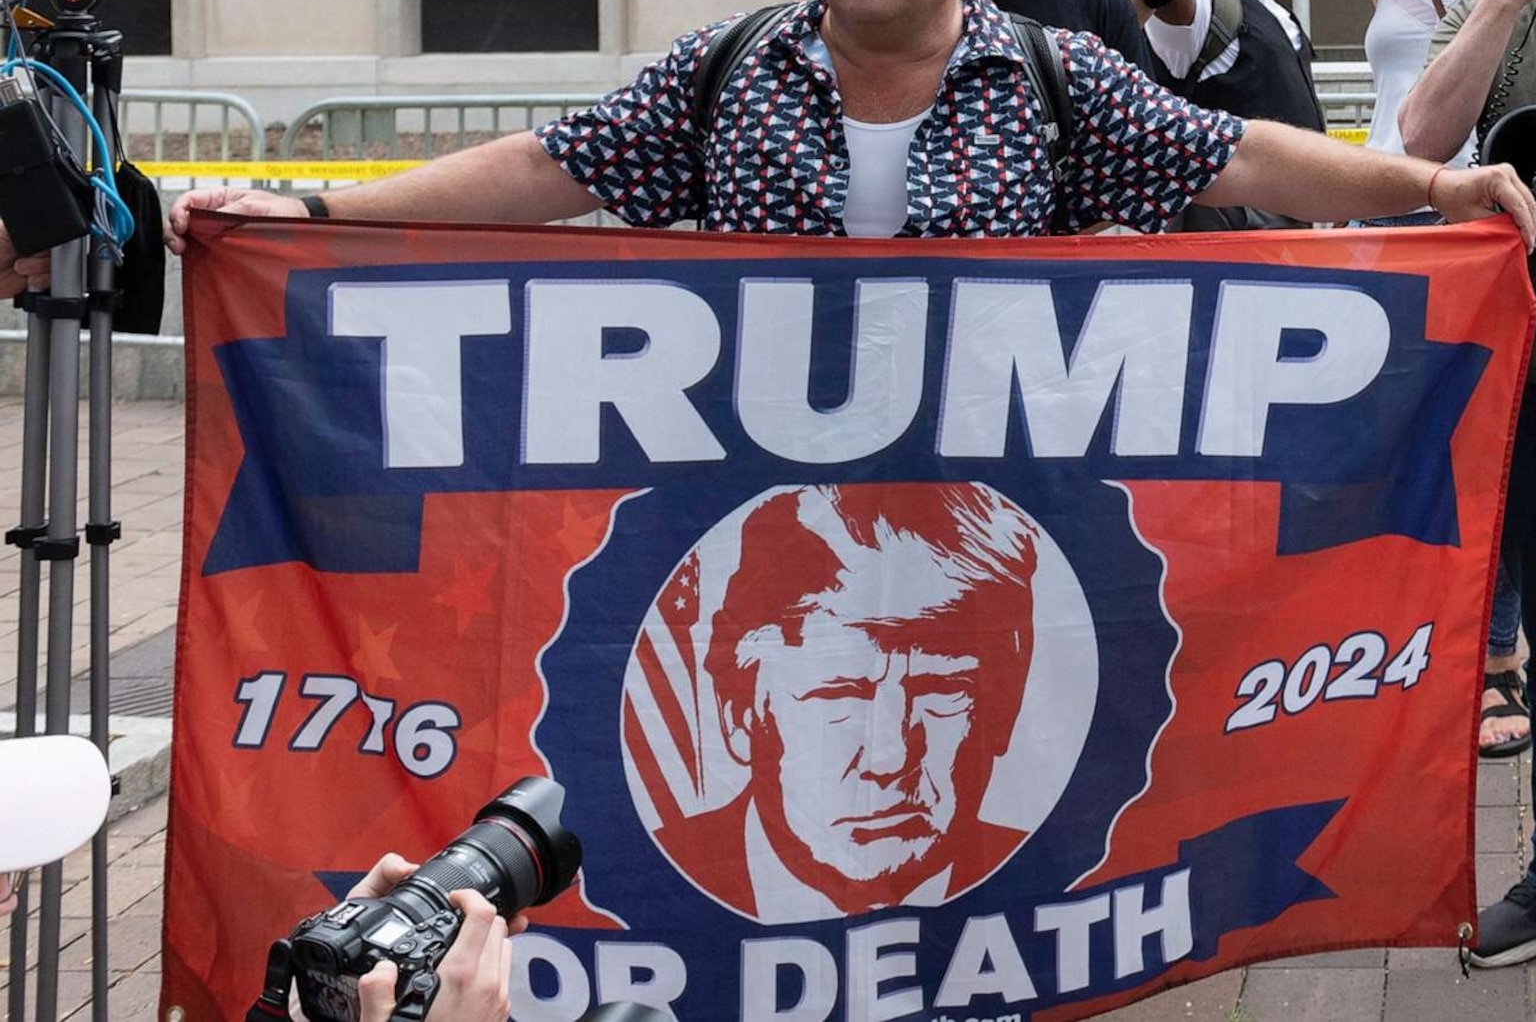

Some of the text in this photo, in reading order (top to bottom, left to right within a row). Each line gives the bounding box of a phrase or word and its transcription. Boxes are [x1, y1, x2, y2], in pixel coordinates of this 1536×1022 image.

[327, 276, 1392, 470] TRUMP
[1222, 621, 1436, 736] 2024
[739, 866, 1195, 1022] DEATH
